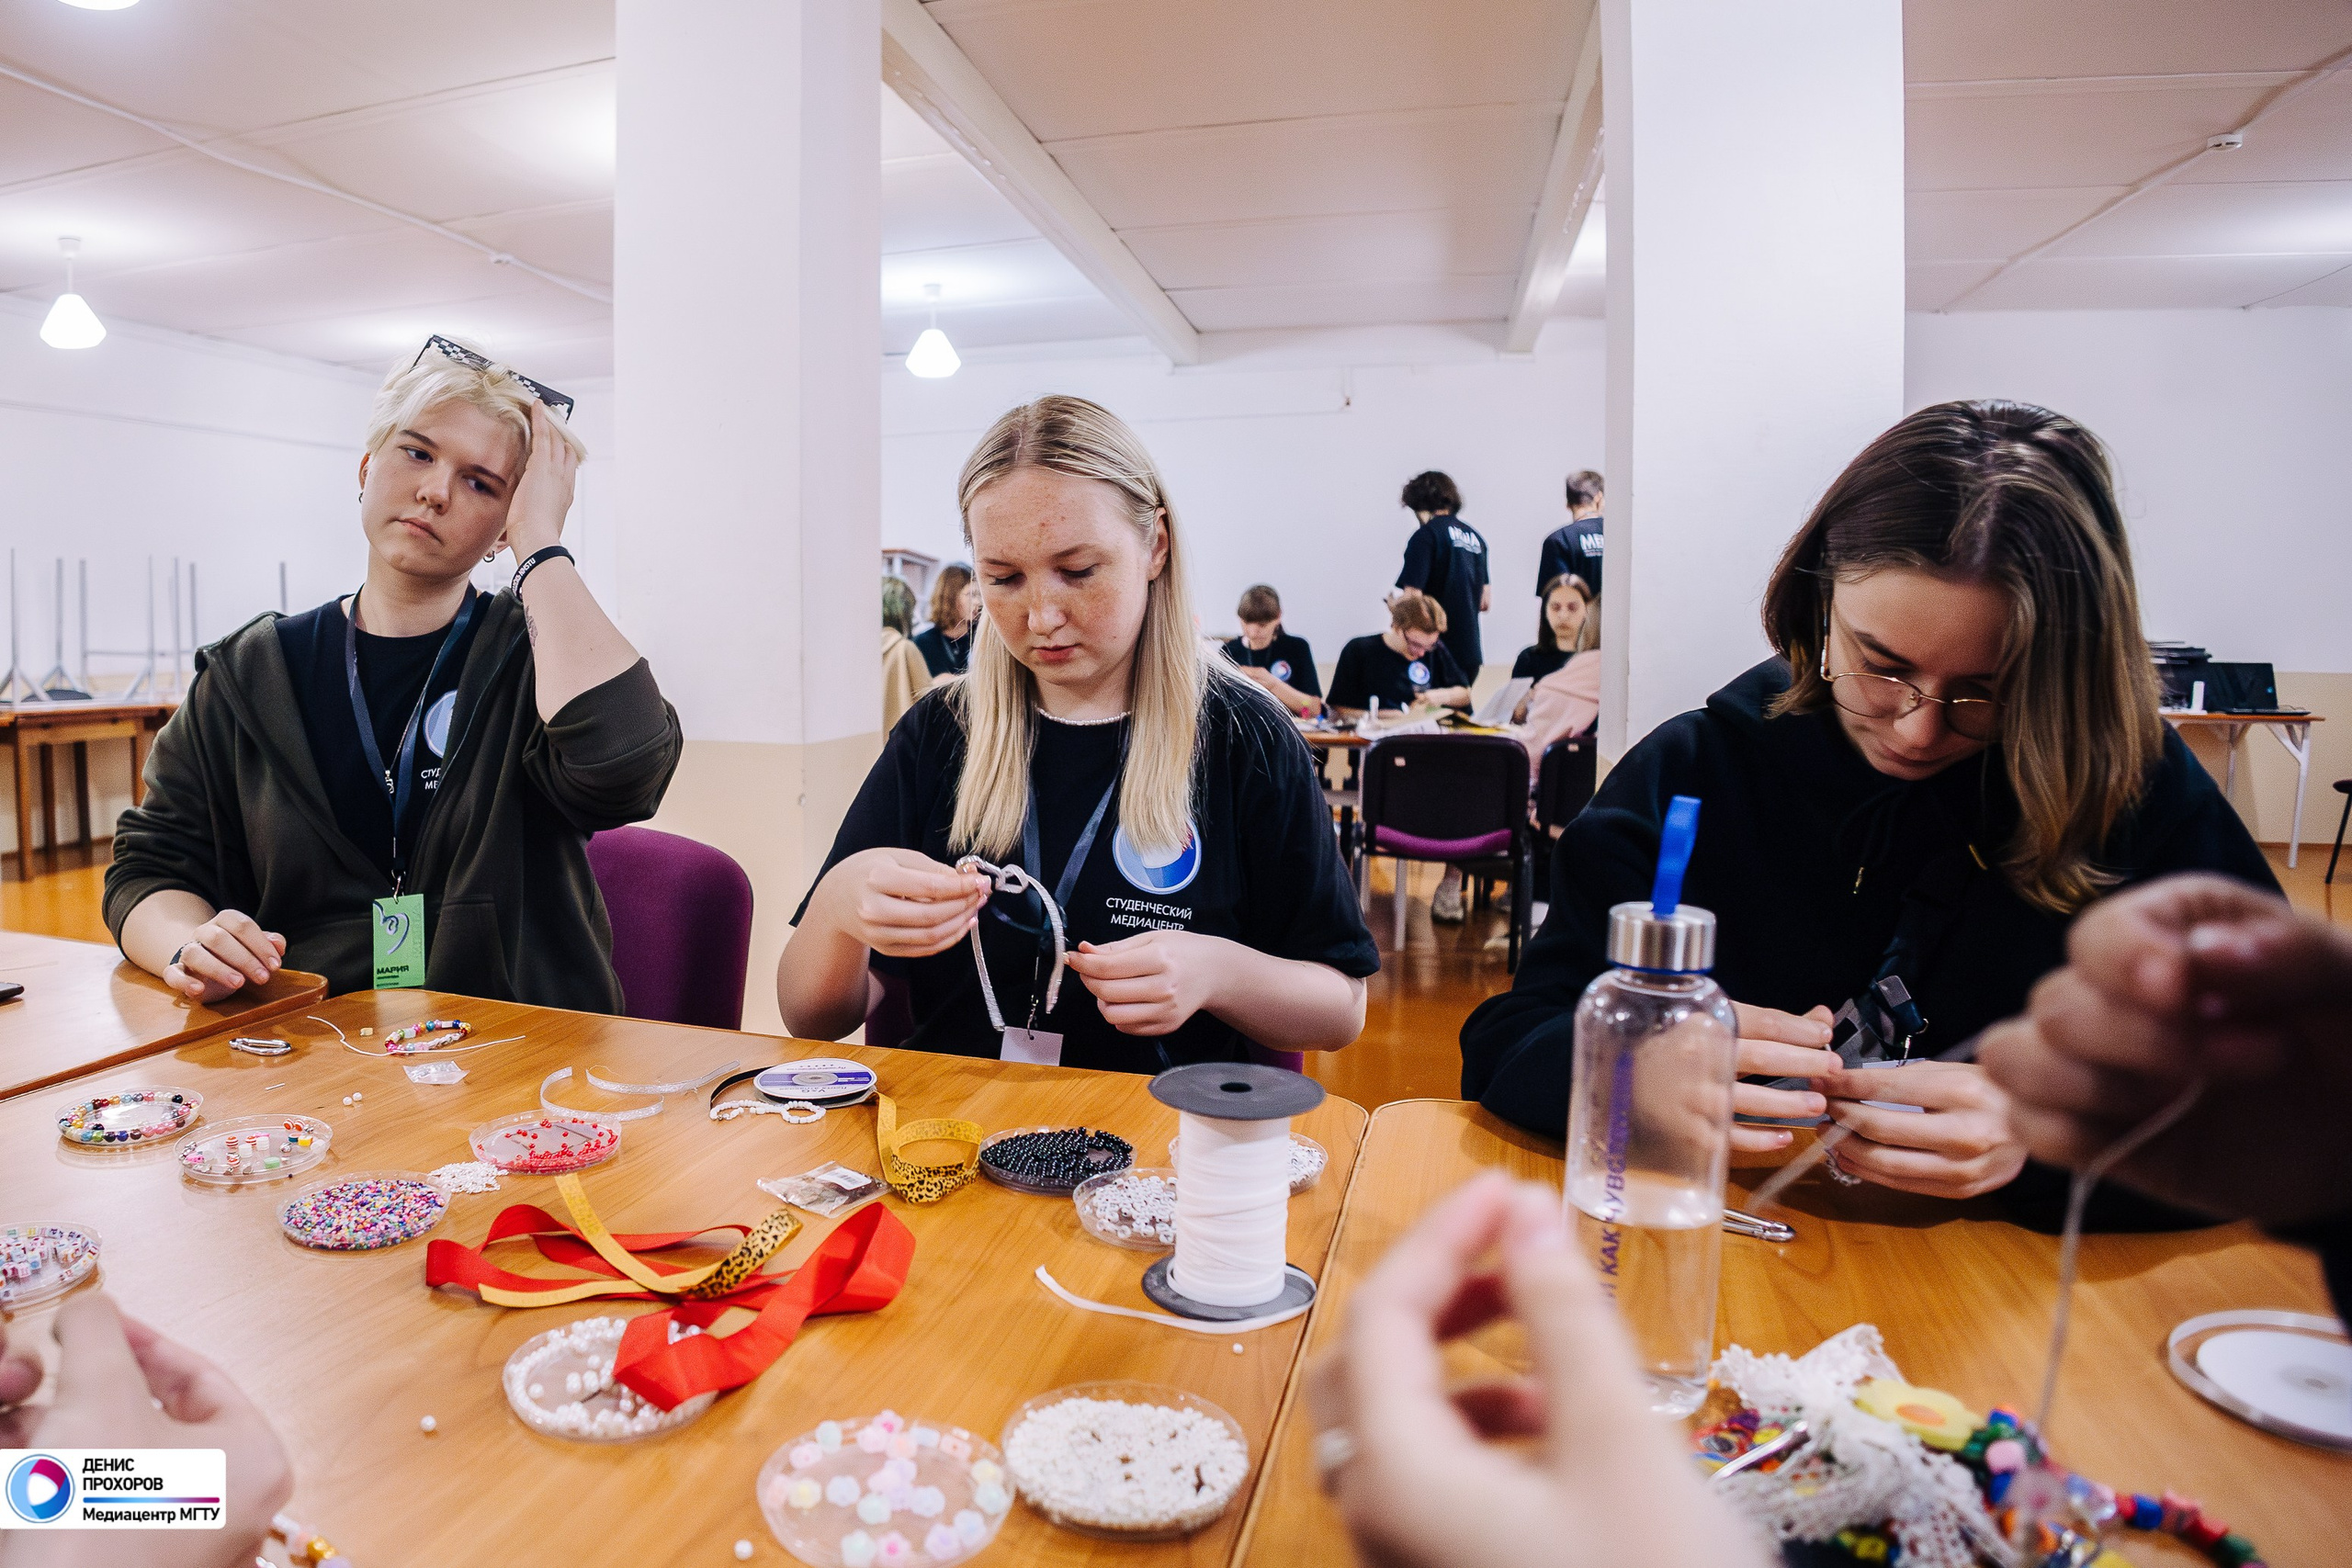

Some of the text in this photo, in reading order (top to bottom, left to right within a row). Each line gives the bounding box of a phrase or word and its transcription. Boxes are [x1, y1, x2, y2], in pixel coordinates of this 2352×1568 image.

[1105, 897, 1193, 920] СТУДЕНЧЕСКИЙ
[1110, 913, 1185, 931] МЕДИАЦЕНТР
[377, 964, 410, 975] МАРИЯ
